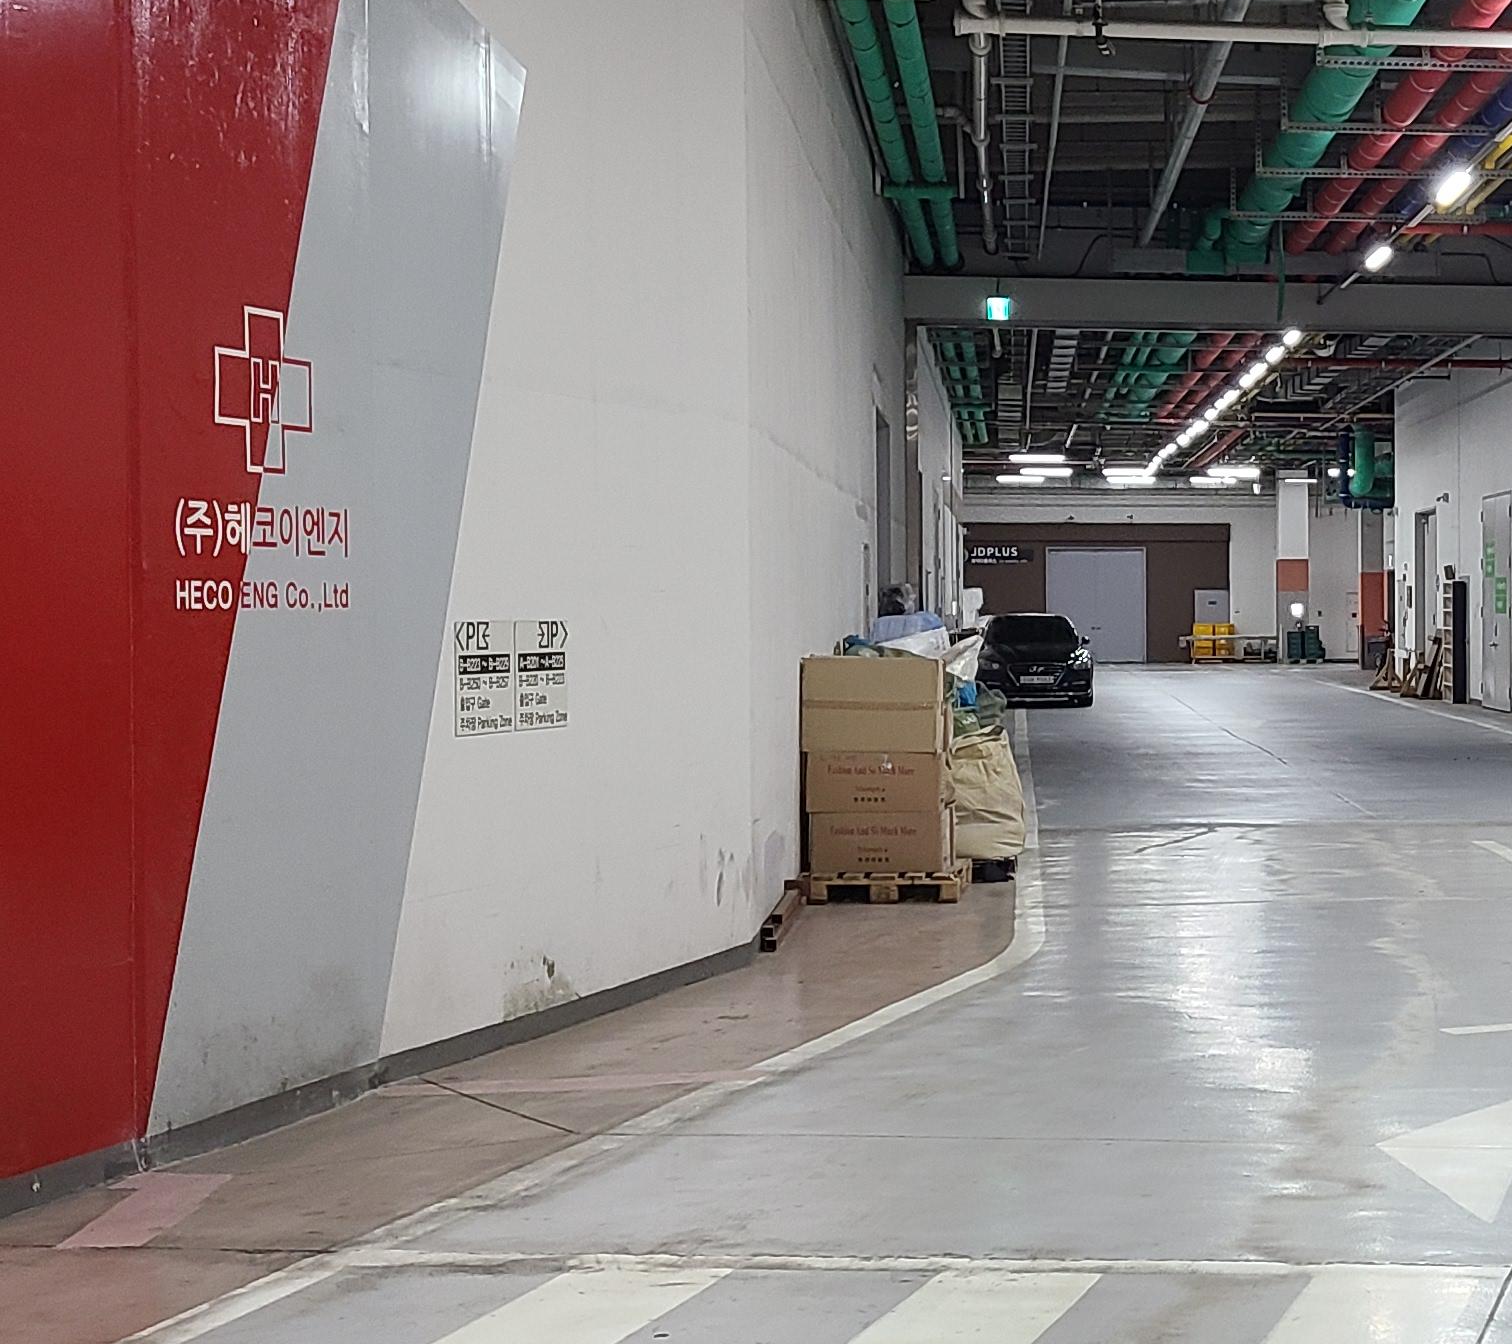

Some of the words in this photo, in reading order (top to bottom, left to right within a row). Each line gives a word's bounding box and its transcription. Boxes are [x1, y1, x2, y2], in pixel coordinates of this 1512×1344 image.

[175, 498, 349, 558] (주)헤코이엔지
[970, 546, 1019, 557] JDPLUS
[175, 579, 233, 610] HECO
[240, 581, 278, 609] ENG
[285, 581, 349, 613] Co.,Ltd
